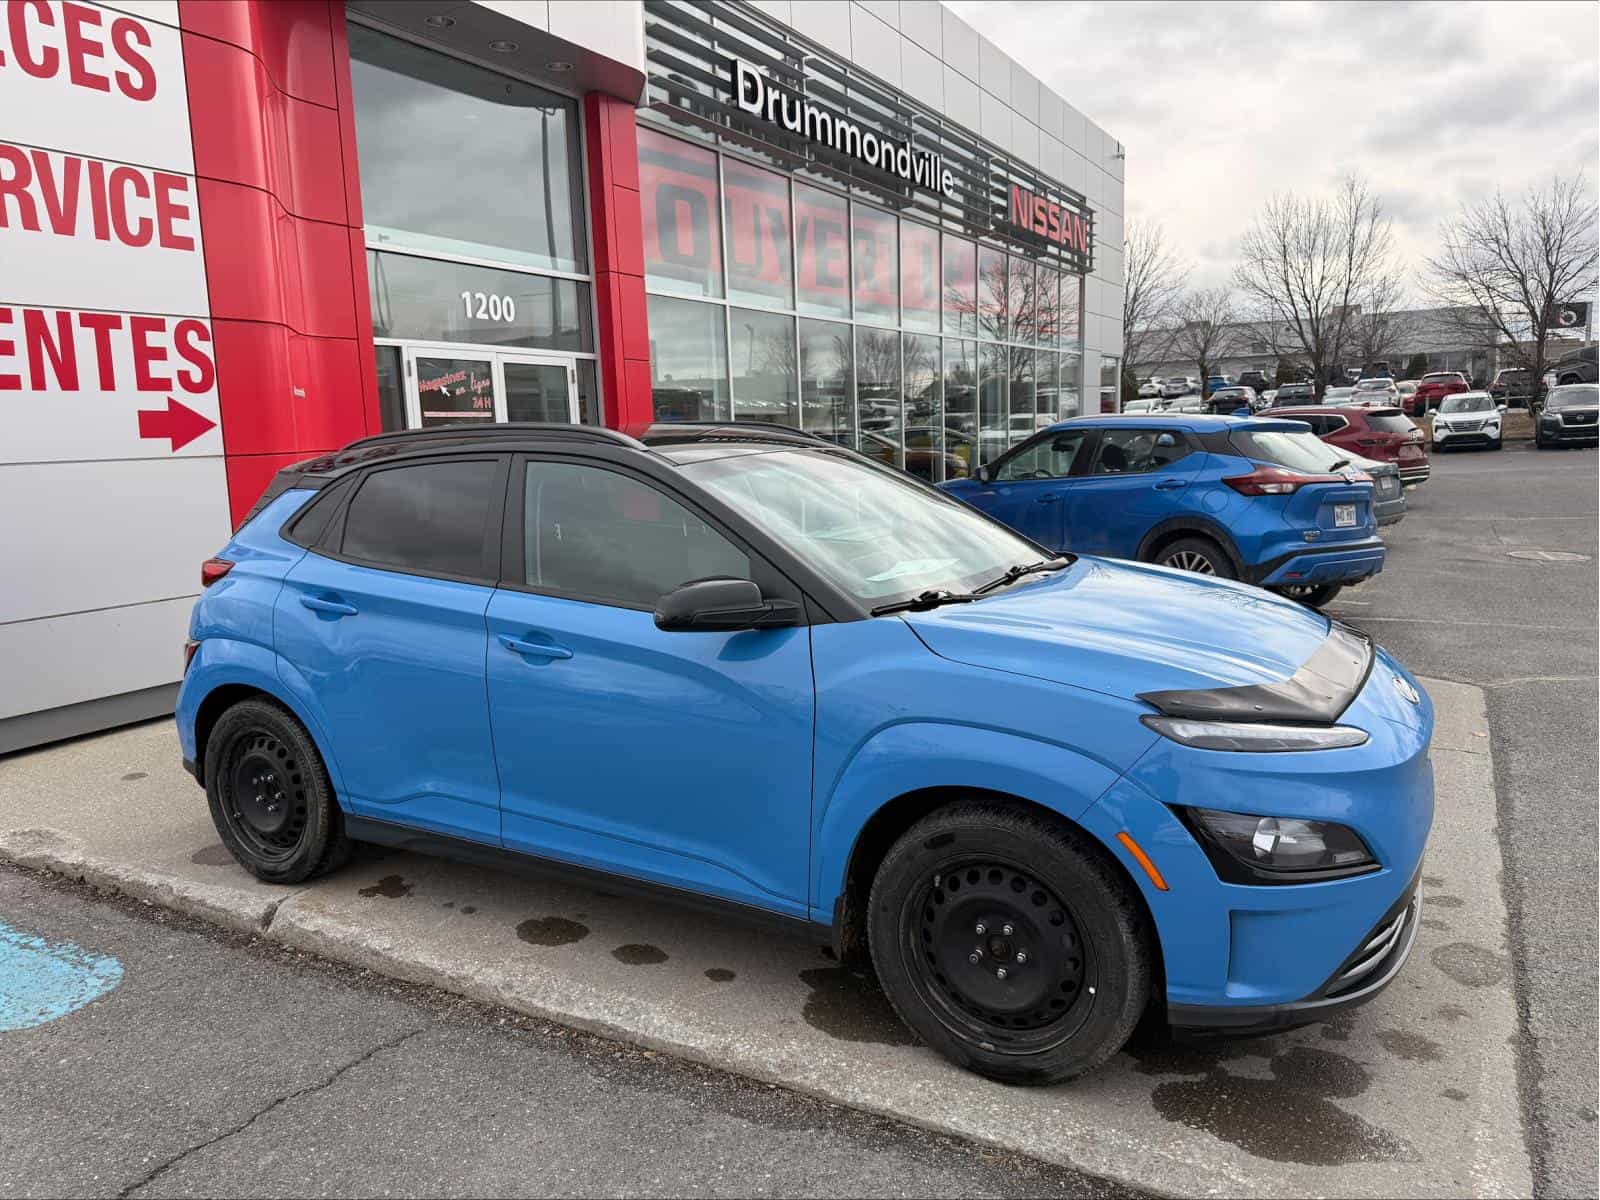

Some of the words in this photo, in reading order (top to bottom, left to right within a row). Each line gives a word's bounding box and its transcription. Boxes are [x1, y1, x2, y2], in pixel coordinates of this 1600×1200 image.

[0, 0, 157, 101] CES
[736, 58, 954, 197] Drummondville
[0, 144, 195, 252] RVICE
[1009, 184, 1088, 254] NISSAN
[0, 307, 215, 394] ENTES
[461, 291, 516, 322] 1200
